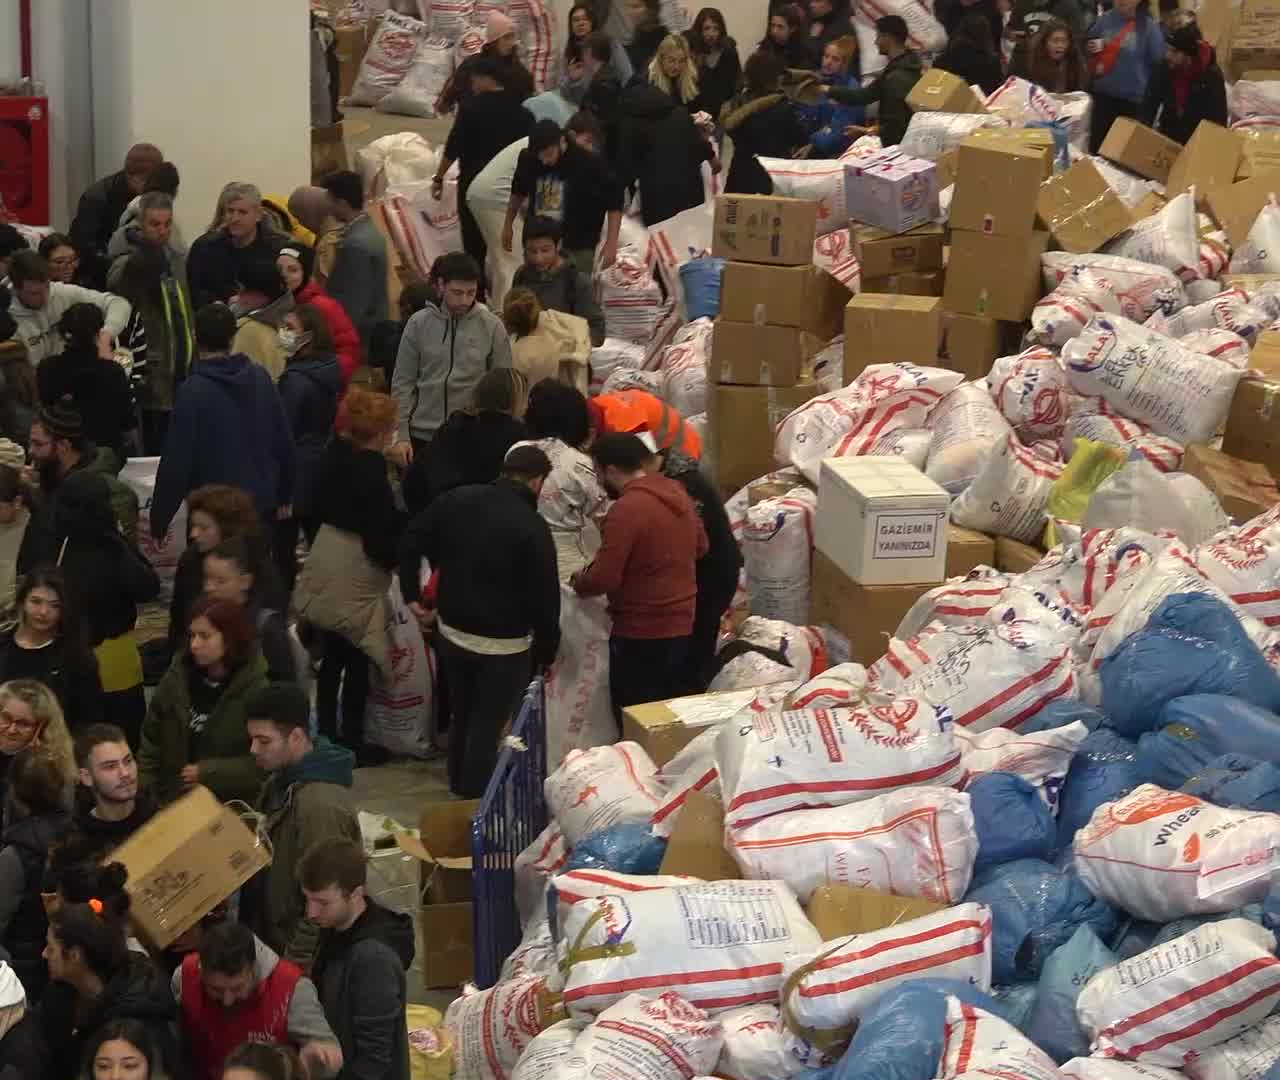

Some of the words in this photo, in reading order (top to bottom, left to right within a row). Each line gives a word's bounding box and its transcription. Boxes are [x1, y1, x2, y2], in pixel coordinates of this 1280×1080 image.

[880, 522, 934, 535] GAZİEMİR
[880, 540, 931, 552] YANINIZDA
[1153, 806, 1210, 846] whea
